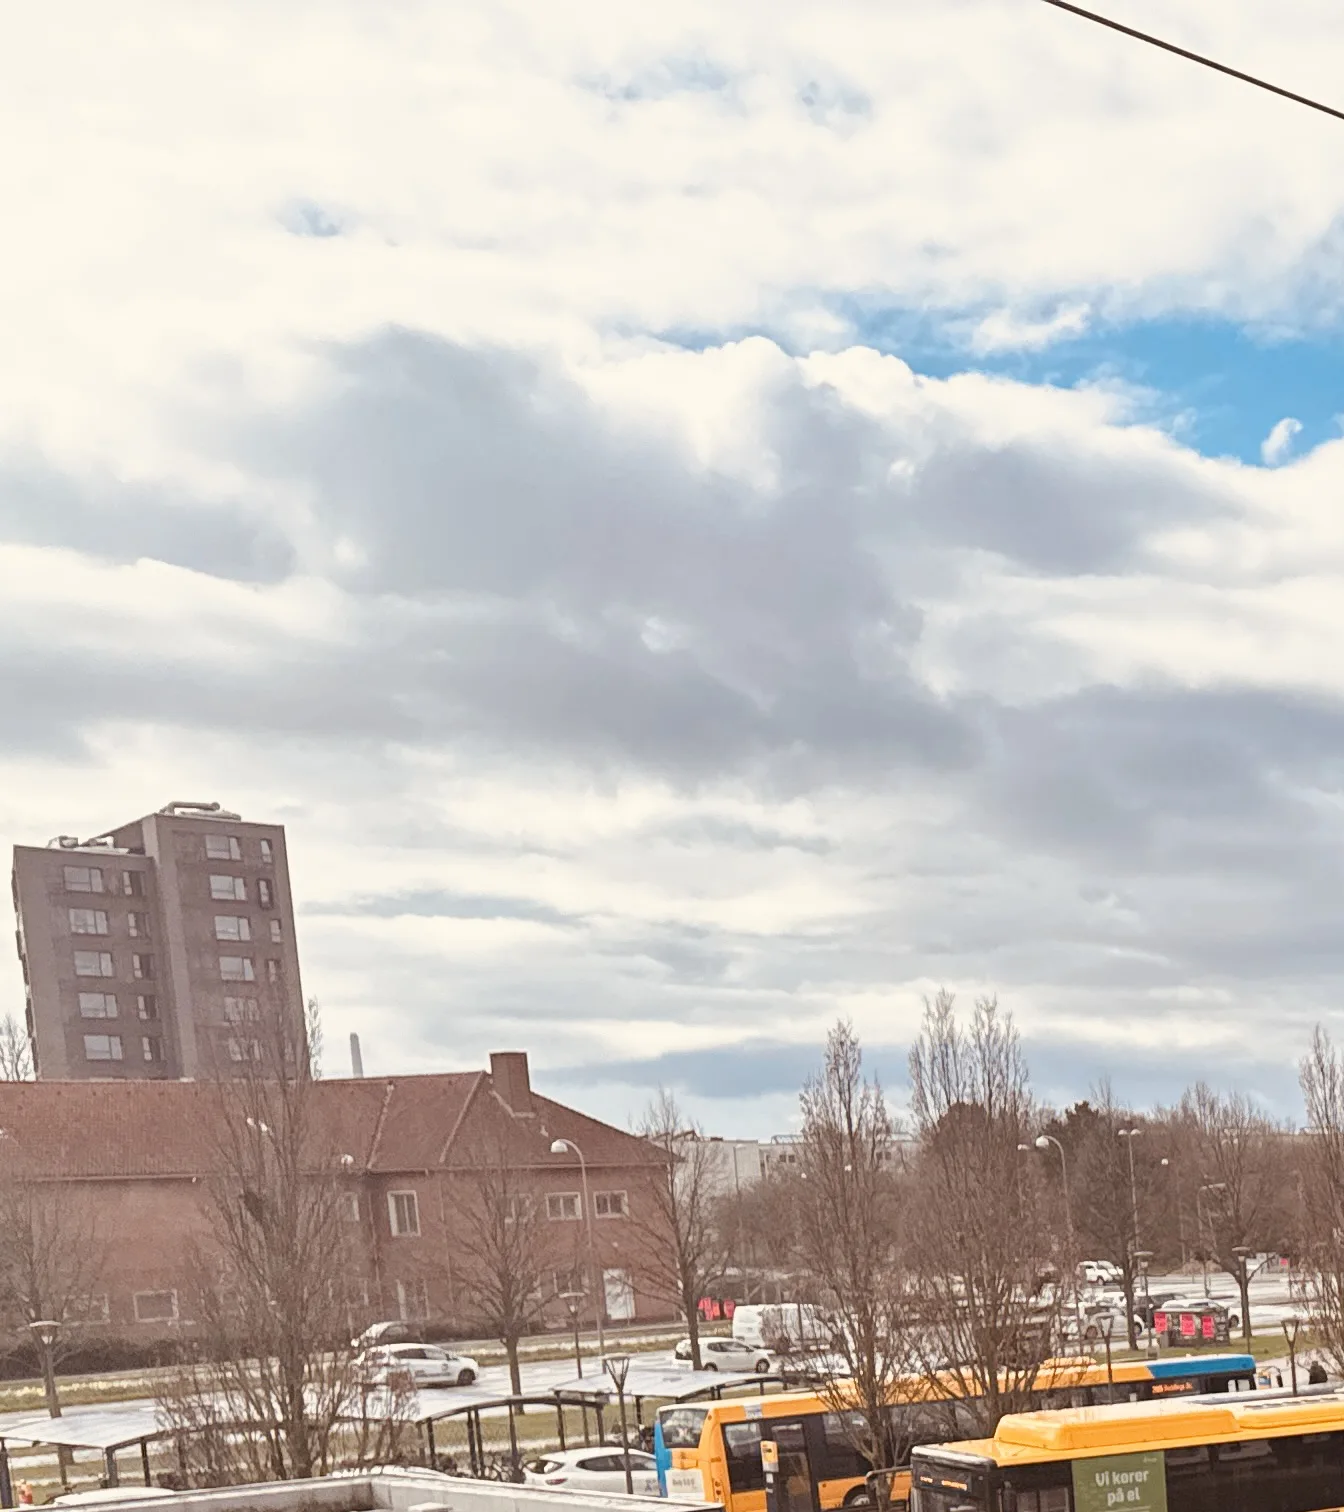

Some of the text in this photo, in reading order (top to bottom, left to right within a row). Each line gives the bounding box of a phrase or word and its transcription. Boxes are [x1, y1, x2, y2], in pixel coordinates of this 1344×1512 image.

[1095, 1470, 1110, 1487] Vi
[1107, 1486, 1141, 1507] på el
